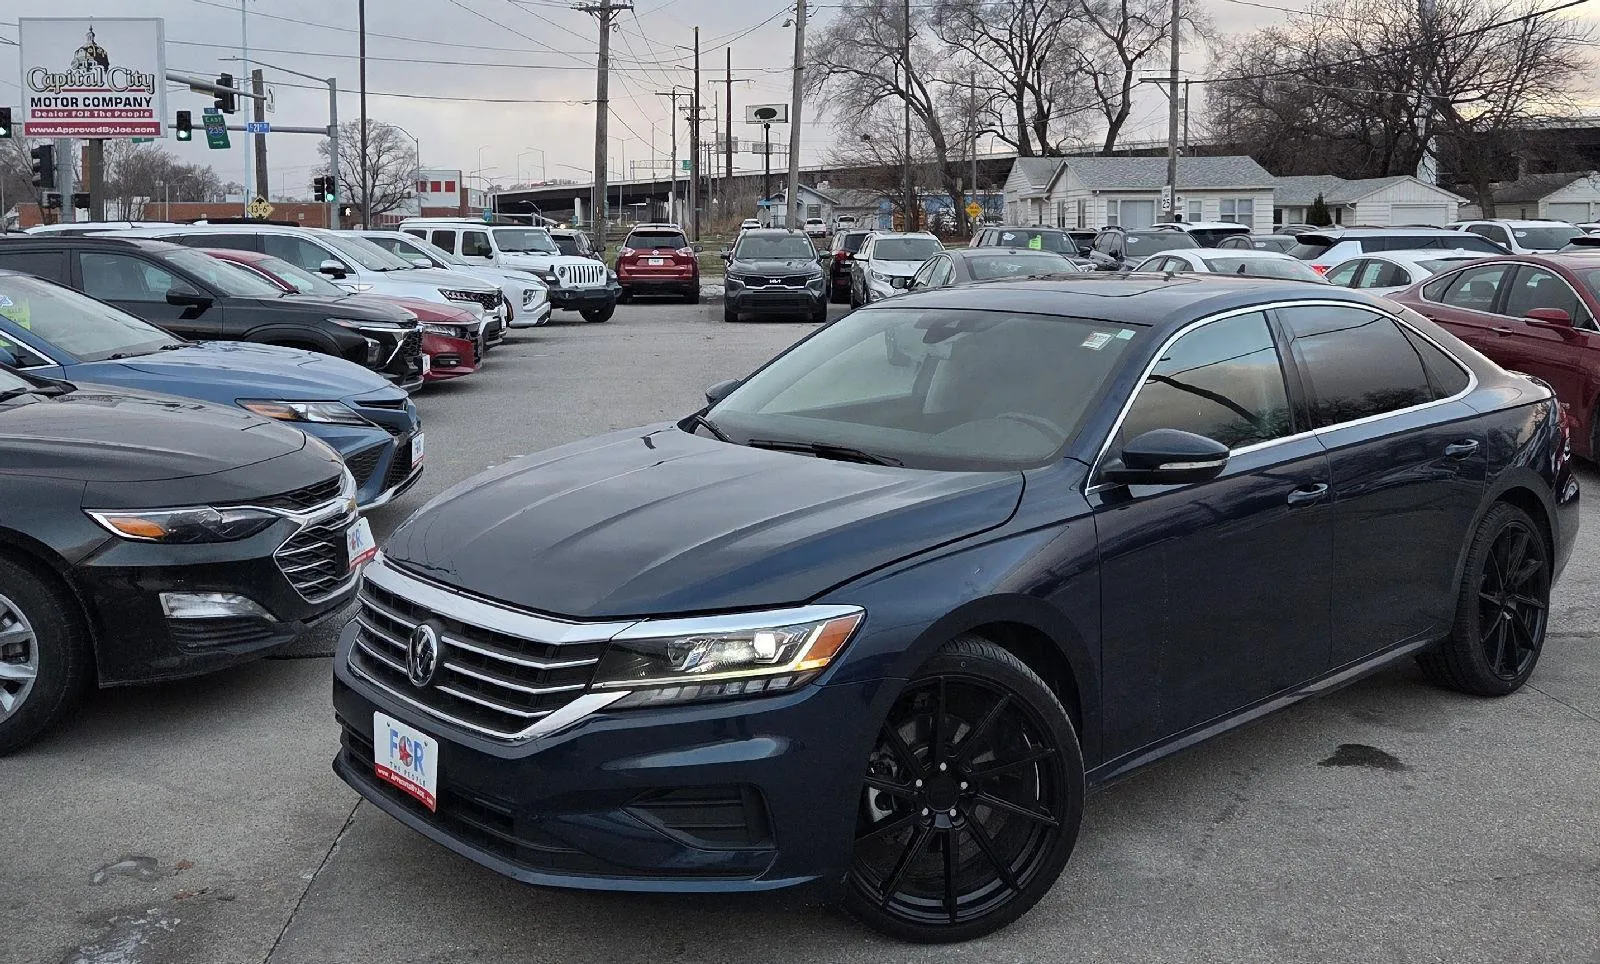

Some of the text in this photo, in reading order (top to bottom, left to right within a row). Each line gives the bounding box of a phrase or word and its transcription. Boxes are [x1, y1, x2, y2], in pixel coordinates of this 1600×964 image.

[27, 66, 155, 94] Capital City
[30, 97, 152, 108] MOTOR COMPANY
[390, 728, 426, 777] FOR
